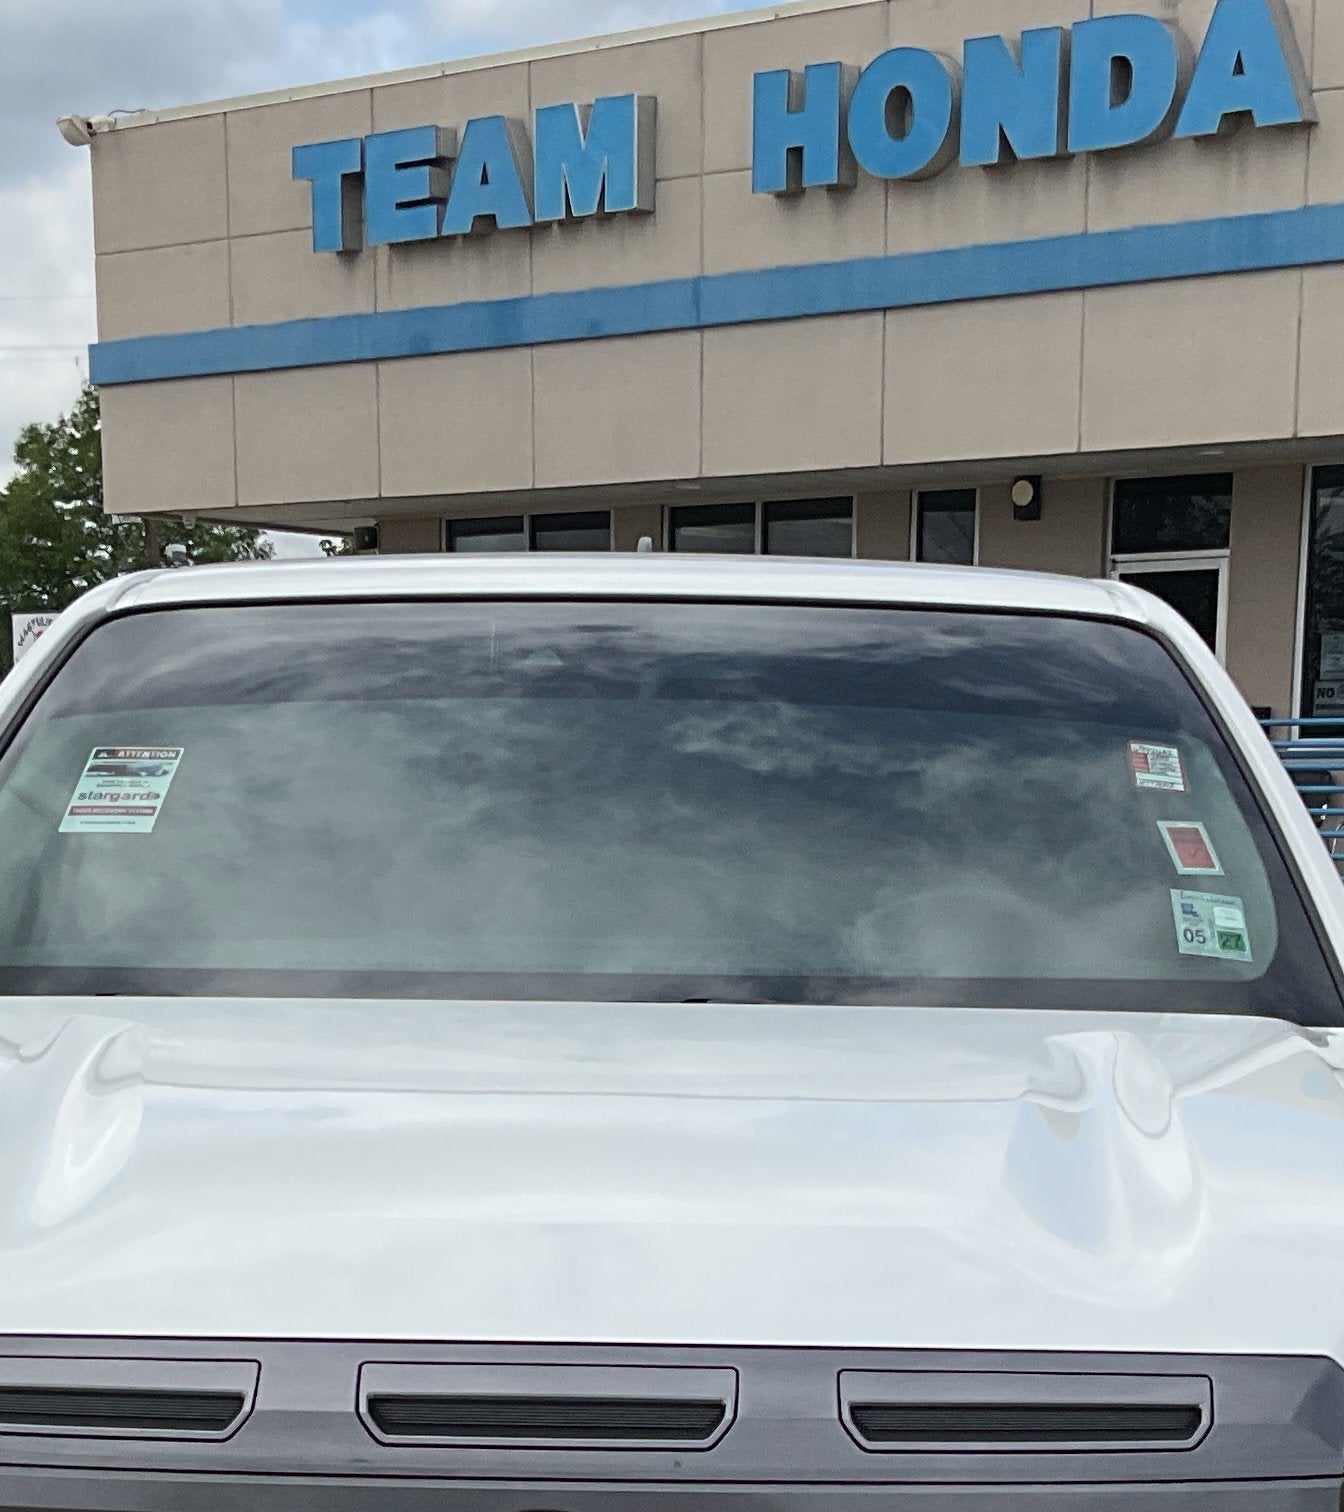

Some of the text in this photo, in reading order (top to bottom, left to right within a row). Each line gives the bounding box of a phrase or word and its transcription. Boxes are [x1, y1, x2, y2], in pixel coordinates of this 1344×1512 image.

[292, 92, 642, 254] TEAM
[752, 0, 1306, 194] HONDA
[1317, 688, 1336, 698] NO
[117, 749, 176, 759] ATTENTION
[1183, 928, 1207, 945] 05
